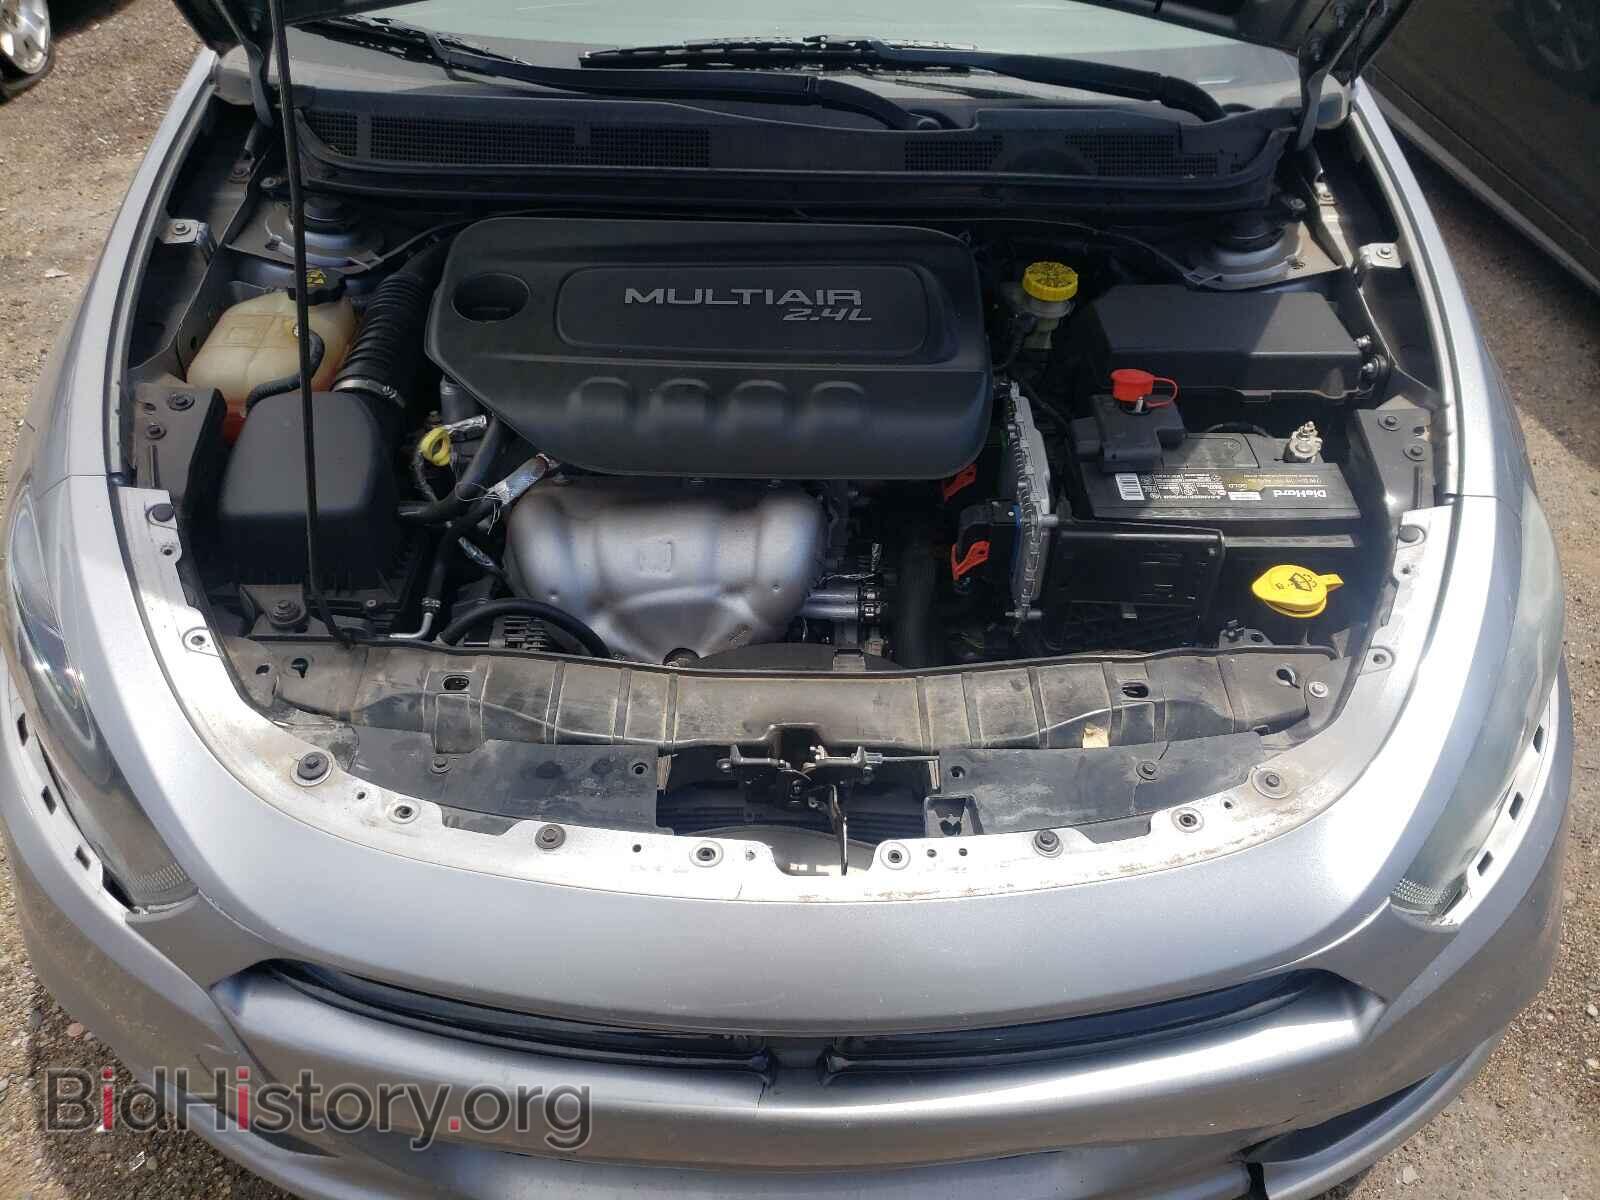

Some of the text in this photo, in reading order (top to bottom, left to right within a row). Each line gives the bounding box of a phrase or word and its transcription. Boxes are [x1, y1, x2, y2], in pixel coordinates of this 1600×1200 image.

[624, 288, 862, 305] MULTIAIR
[782, 308, 872, 321] 2.4L
[1272, 489, 1327, 498] DieHard
